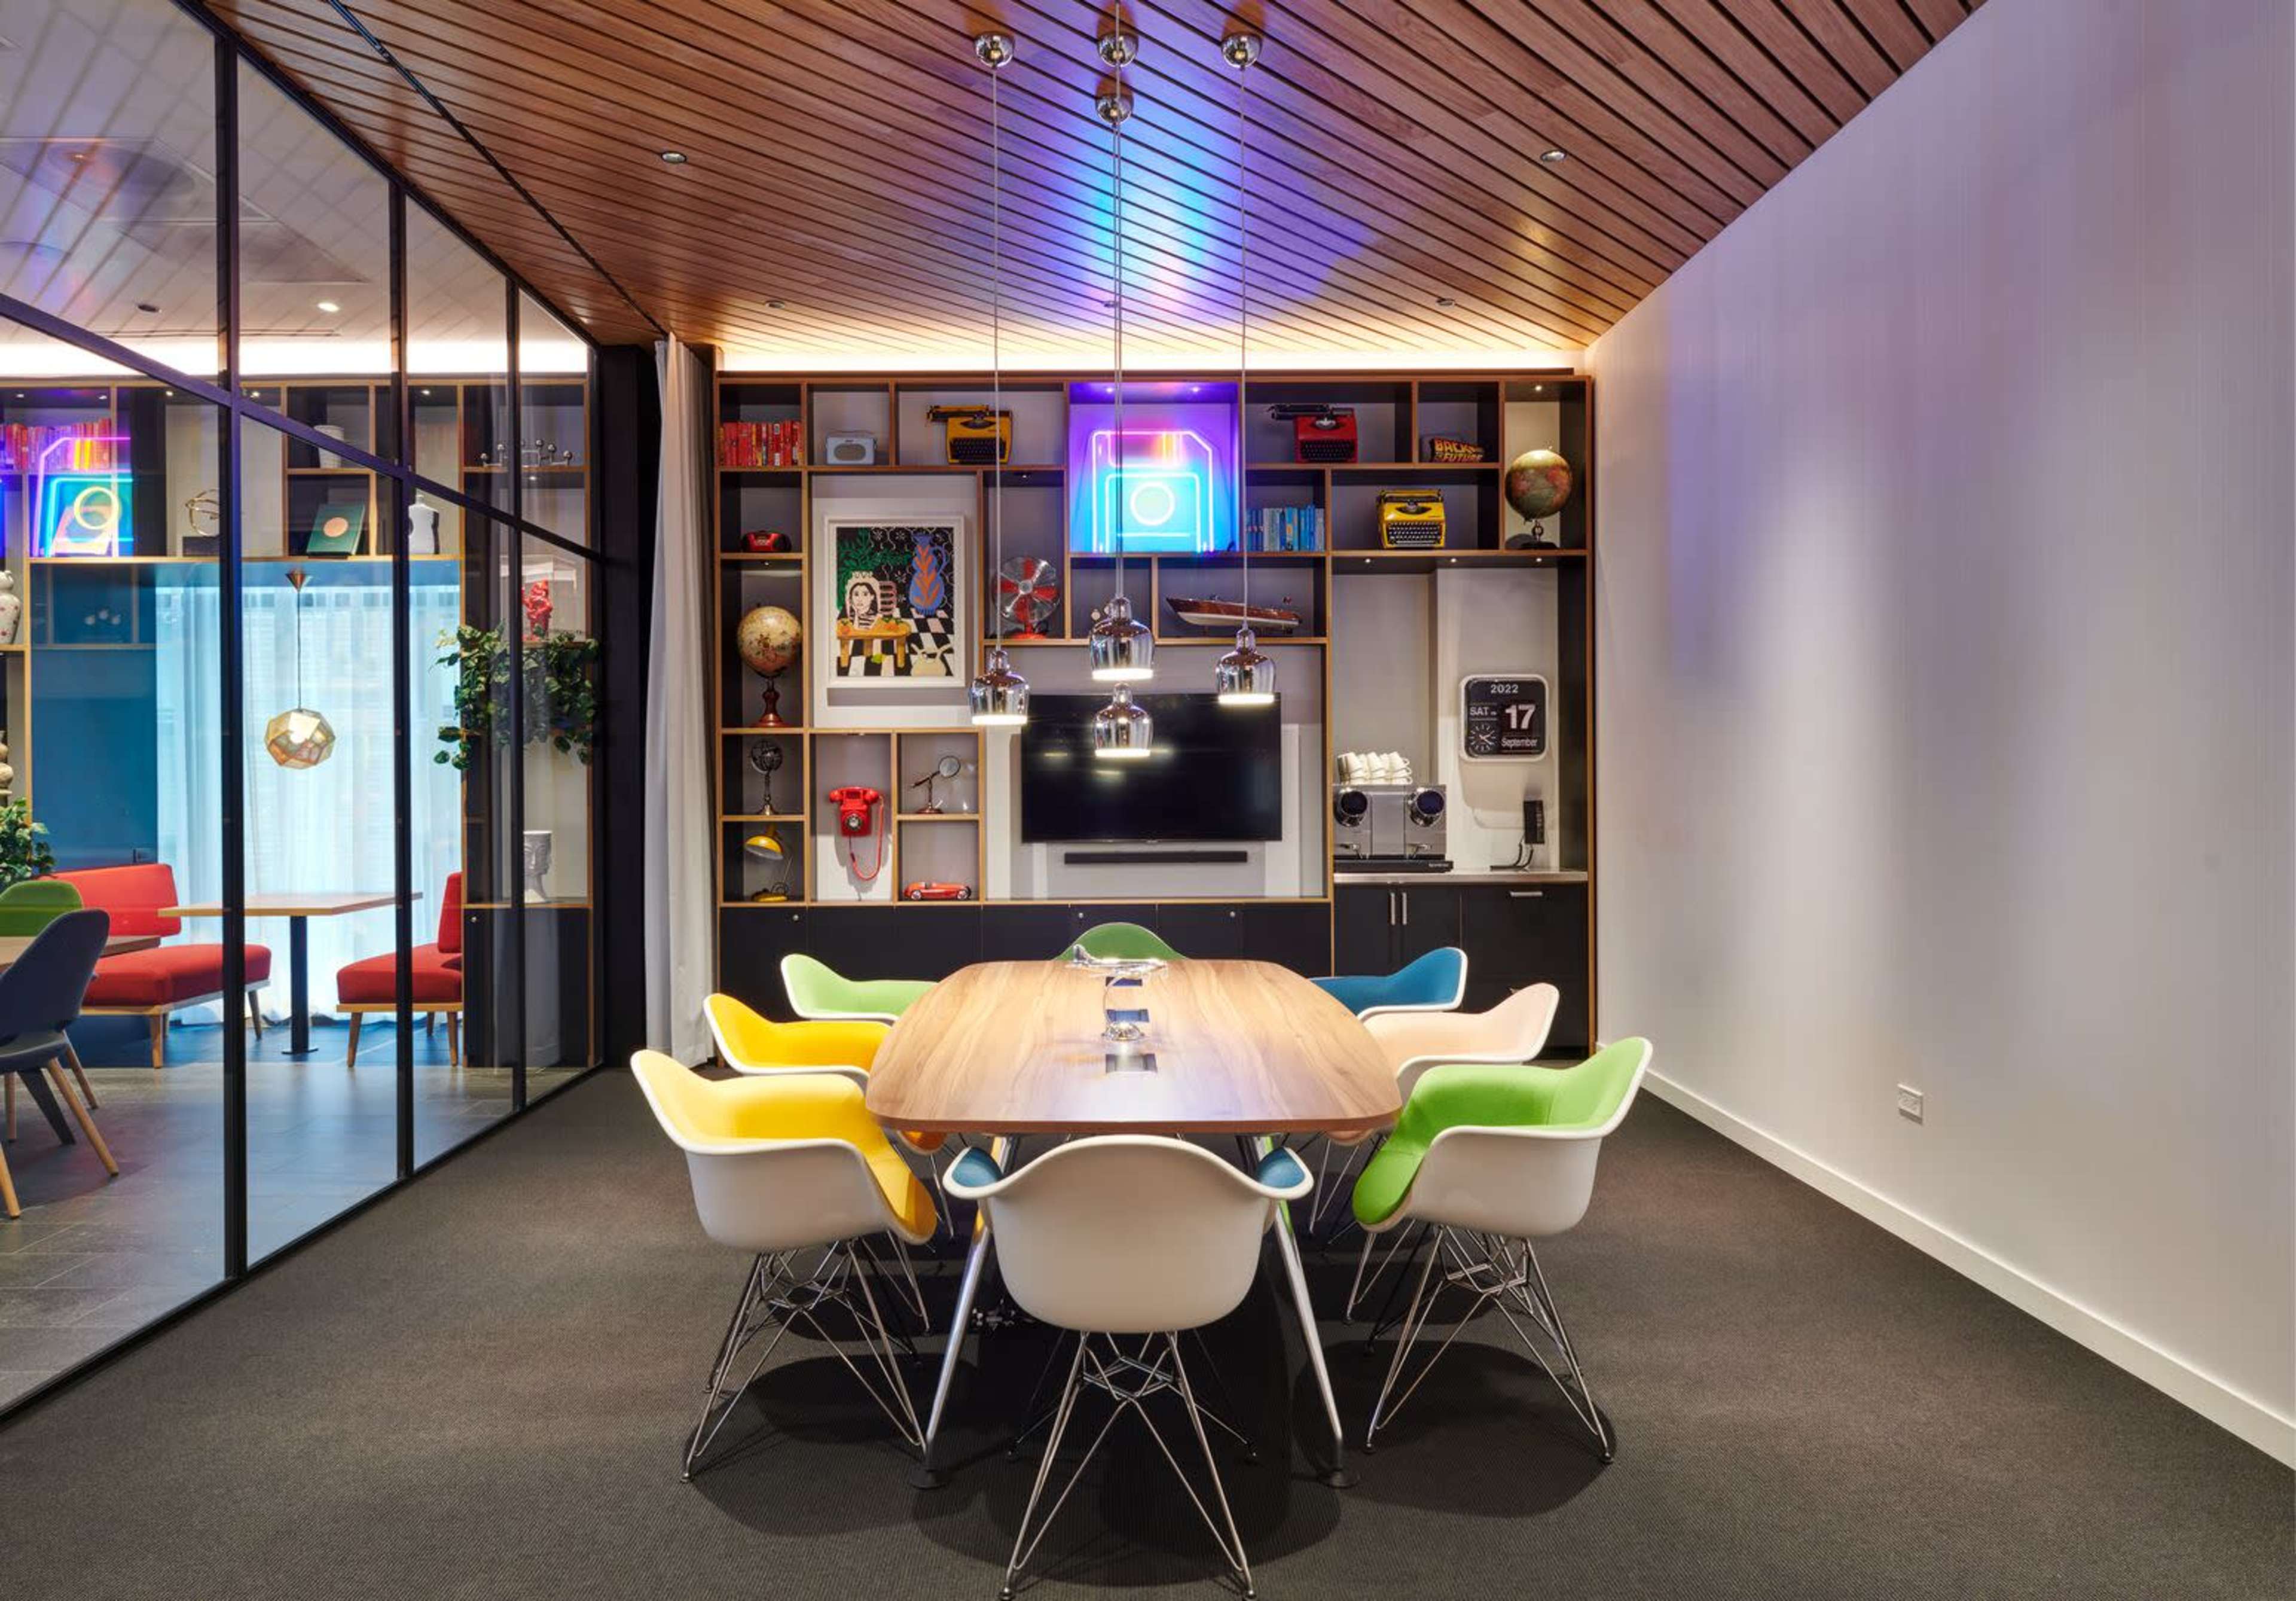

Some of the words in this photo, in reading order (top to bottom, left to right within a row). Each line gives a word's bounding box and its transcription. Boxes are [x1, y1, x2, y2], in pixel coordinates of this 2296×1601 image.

[1434, 438, 1471, 453] BACK
[1491, 684, 1519, 694] 2022
[1470, 706, 1489, 716] SAT
[1505, 704, 1536, 730] 17
[1501, 737, 1538, 749] September
